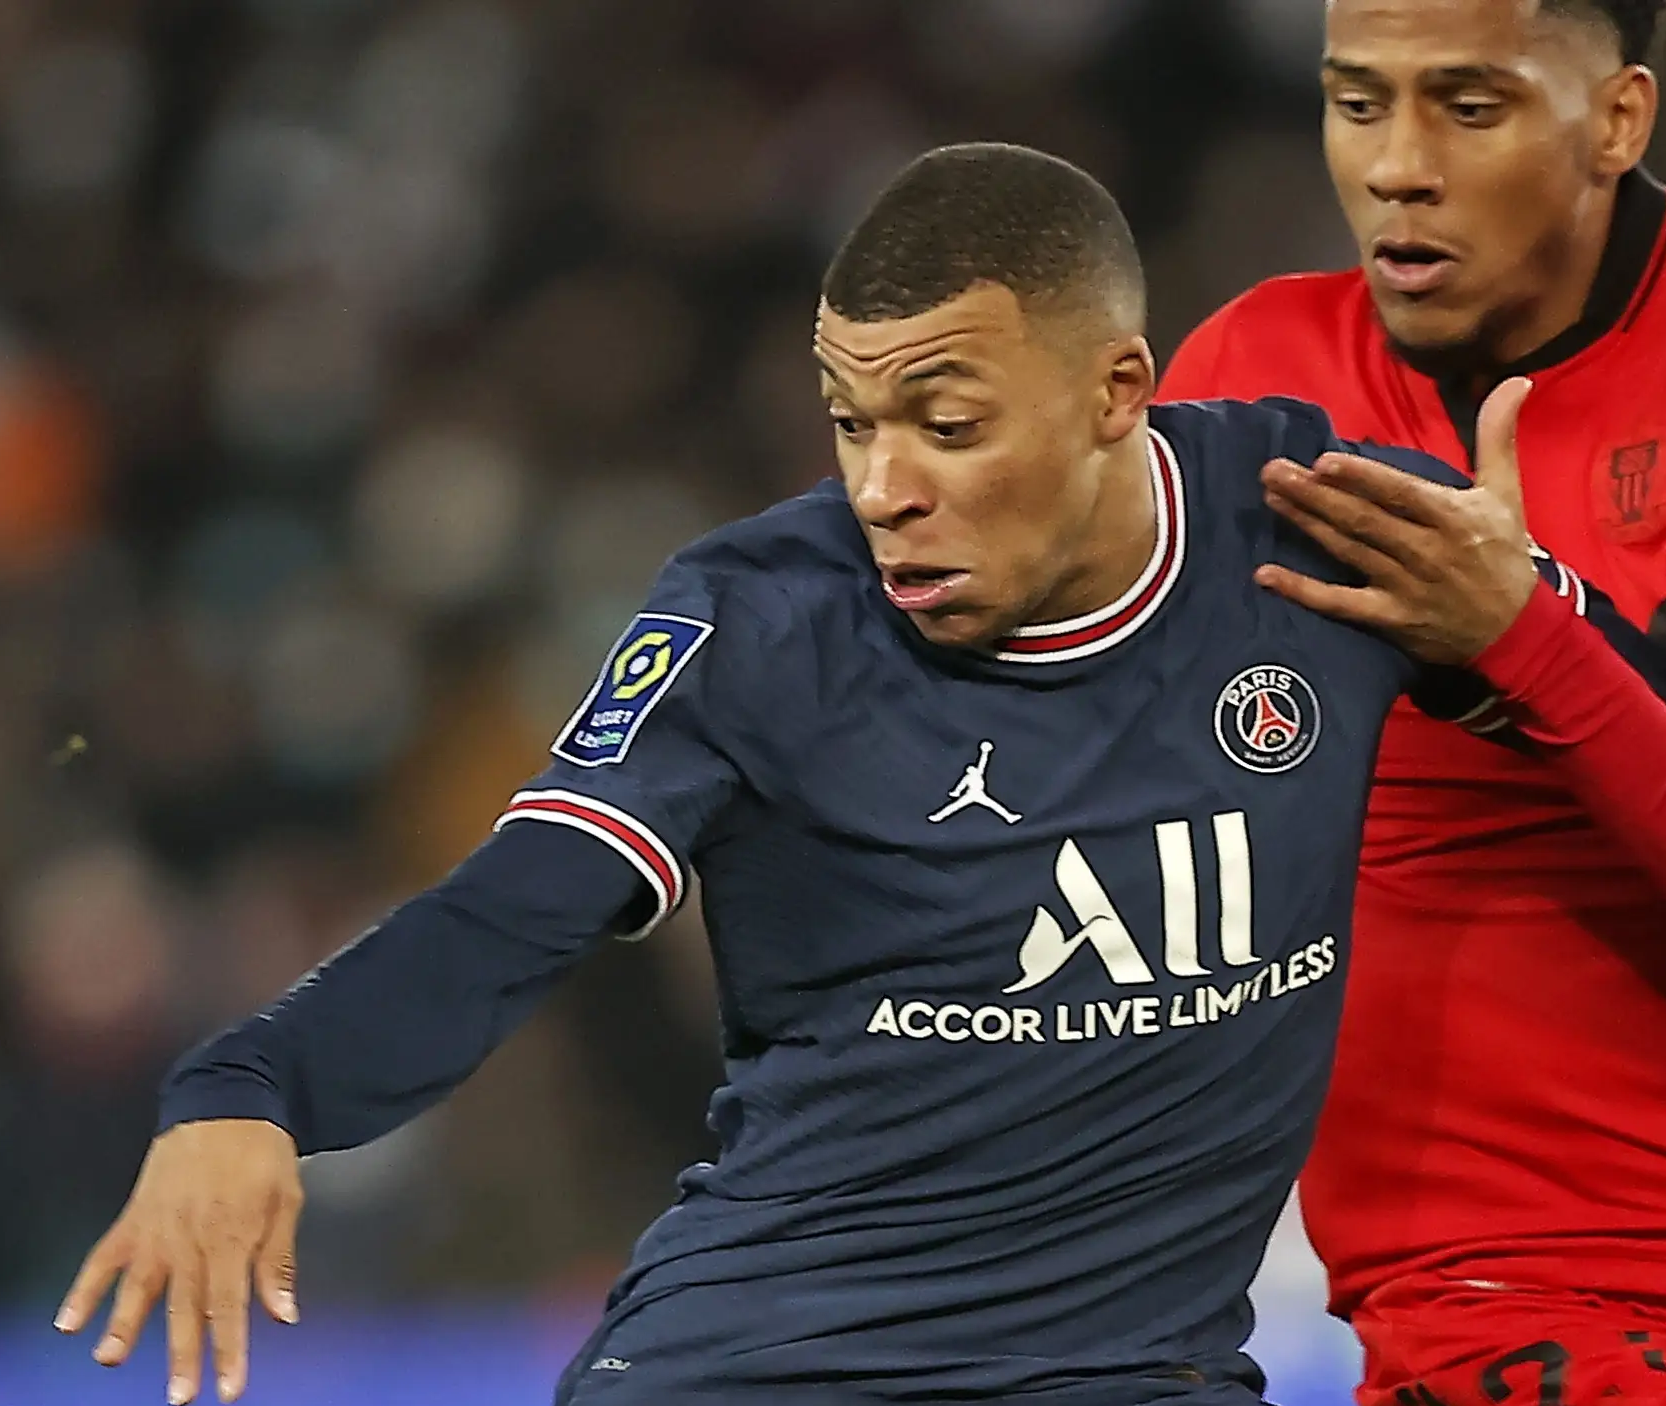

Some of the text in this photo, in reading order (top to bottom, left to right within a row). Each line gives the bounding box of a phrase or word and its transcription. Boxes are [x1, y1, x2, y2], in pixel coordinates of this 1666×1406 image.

[1225, 671, 1293, 706] PARIS
[866, 935, 1337, 1042] ACCOR LIVE LIMITLESS
